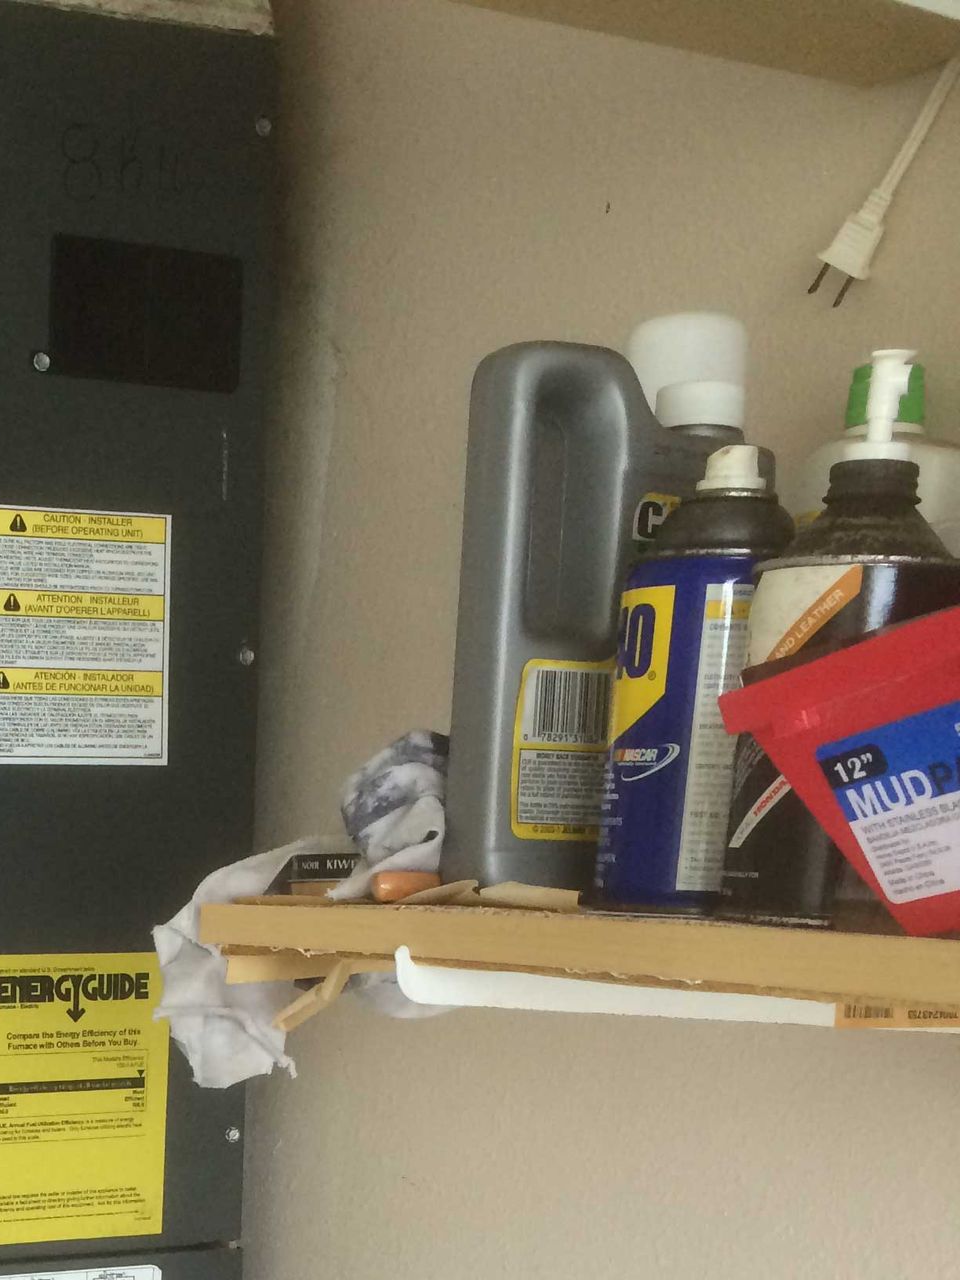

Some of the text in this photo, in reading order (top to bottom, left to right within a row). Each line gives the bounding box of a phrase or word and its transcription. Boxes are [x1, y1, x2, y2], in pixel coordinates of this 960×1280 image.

[43, 513, 133, 527] CAUTION INSTALLER
[32, 524, 144, 538] (BEFORE OPERATING UNIT)
[36, 594, 140, 607] ATTENTION INSTALLEUR
[83, 673, 134, 682] INSTALADOR
[12, 682, 43, 692] (ANTES
[45, 683, 58, 692] DE
[58, 683, 107, 692] FUNCIONAR
[623, 748, 658, 762] NASCAR
[845, 768, 933, 820] MUD
[886, 806, 938, 829] STAINLESS
[326, 859, 355, 870] KIWI
[6, 1028, 141, 1042] Compare the Energy Efficiency of this
[7, 1042, 38, 1051] Furnace
[39, 1041, 55, 1050] with
[56, 1040, 81, 1049] Others
[82, 1040, 107, 1049] Before
[108, 1039, 122, 1047] You
